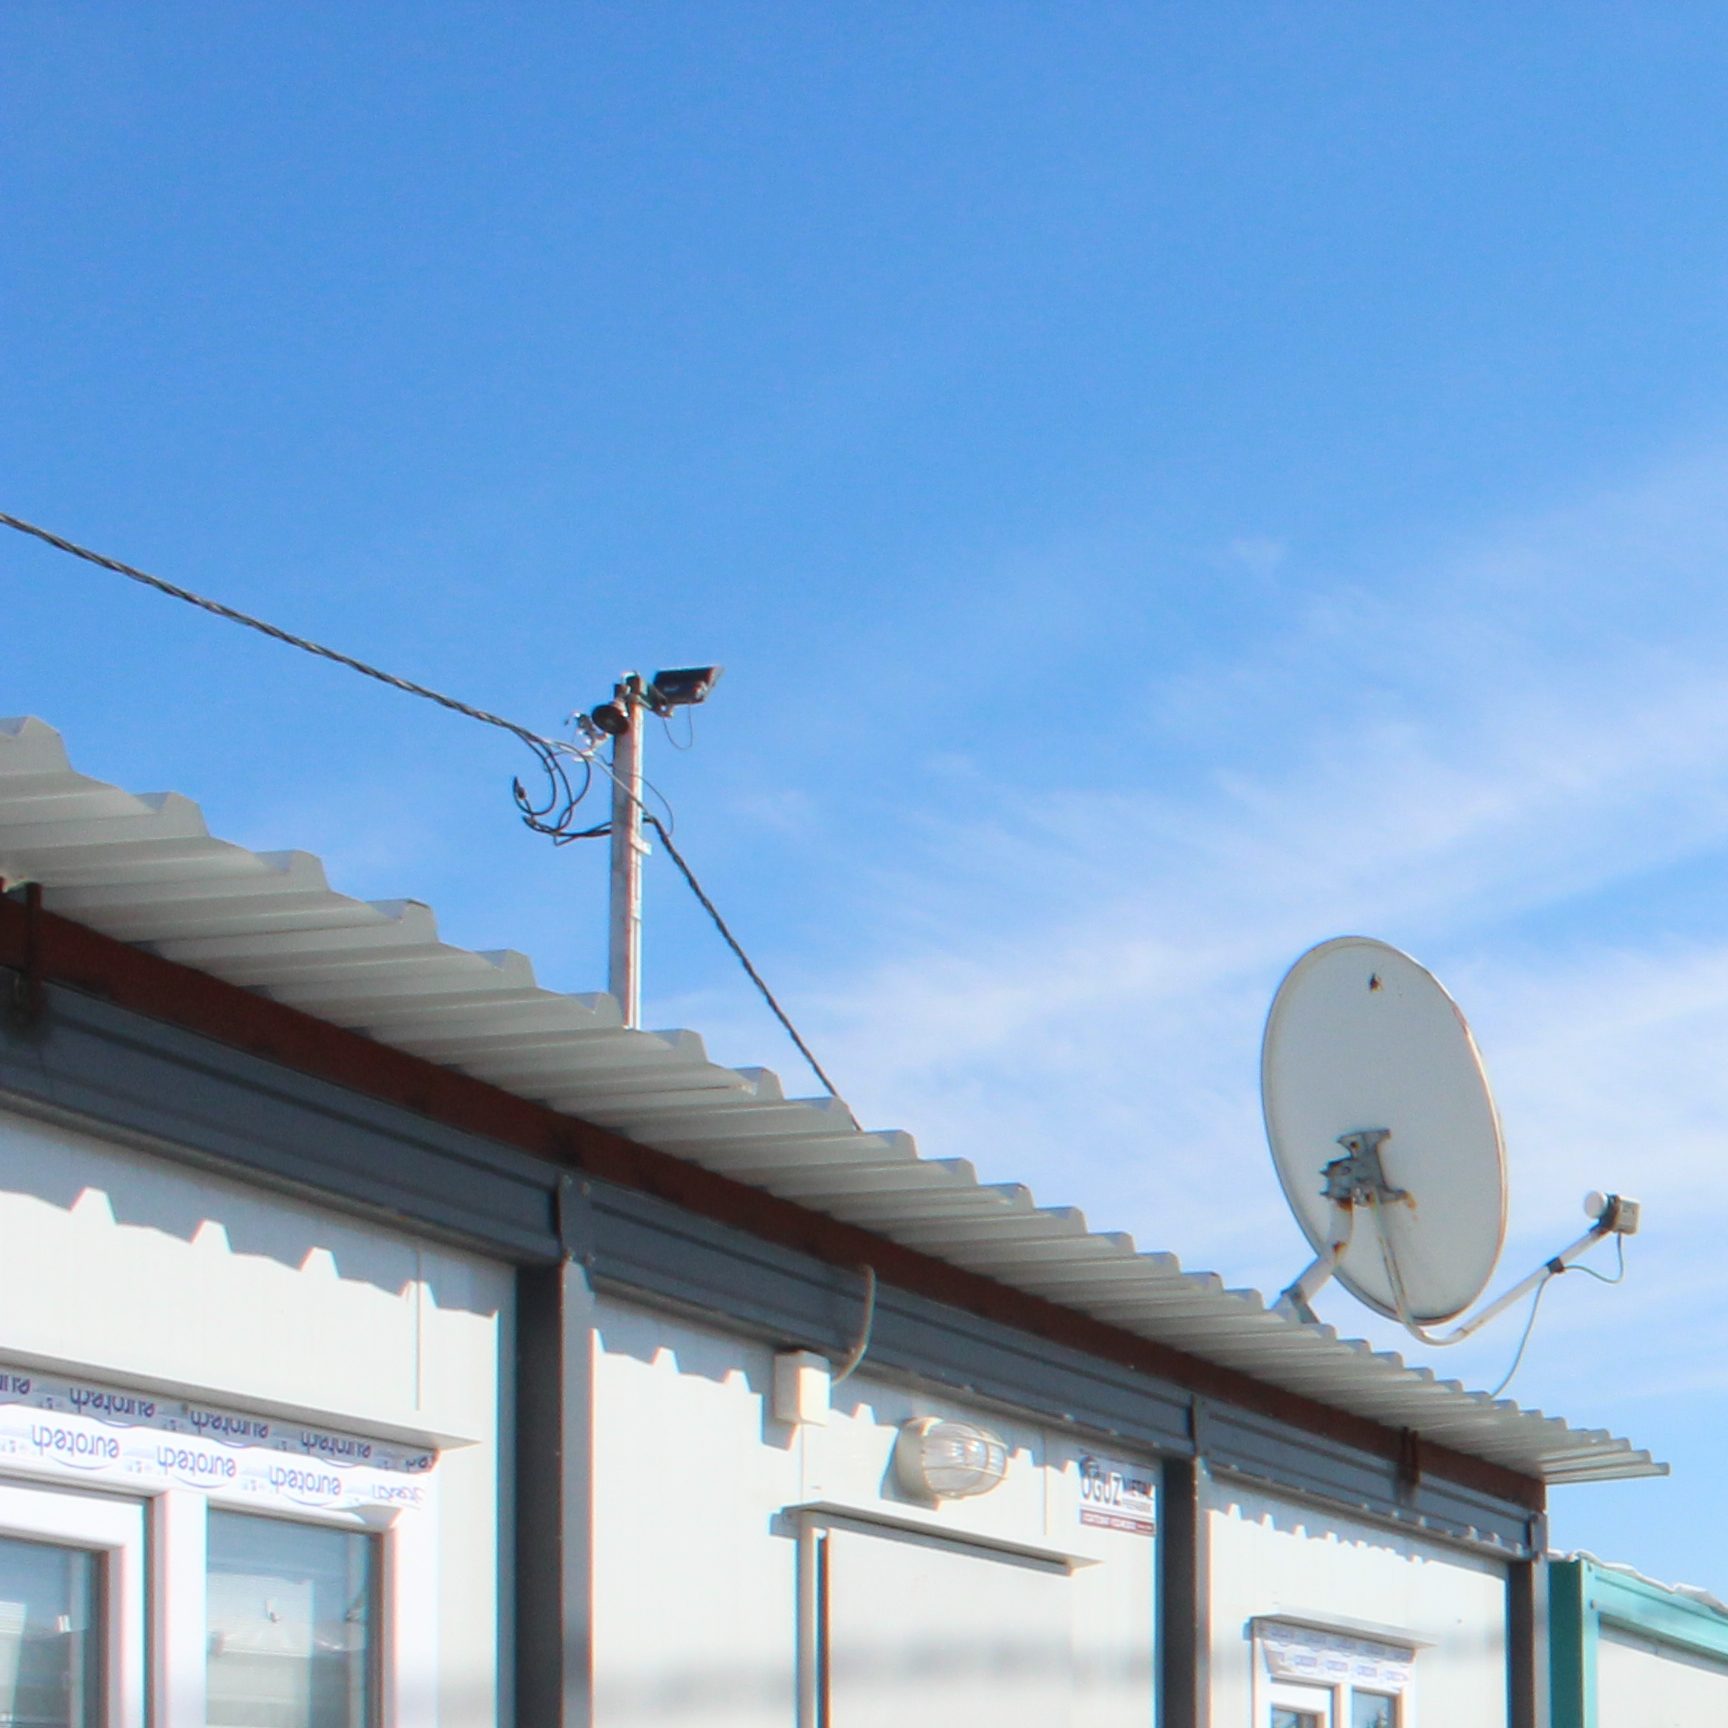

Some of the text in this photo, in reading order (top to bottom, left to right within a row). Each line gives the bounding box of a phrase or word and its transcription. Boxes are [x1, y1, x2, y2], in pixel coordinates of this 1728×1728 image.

[30, 1423, 120, 1459] eurotech
[156, 1444, 237, 1478] eurotech
[268, 1464, 342, 1496] eurotech
